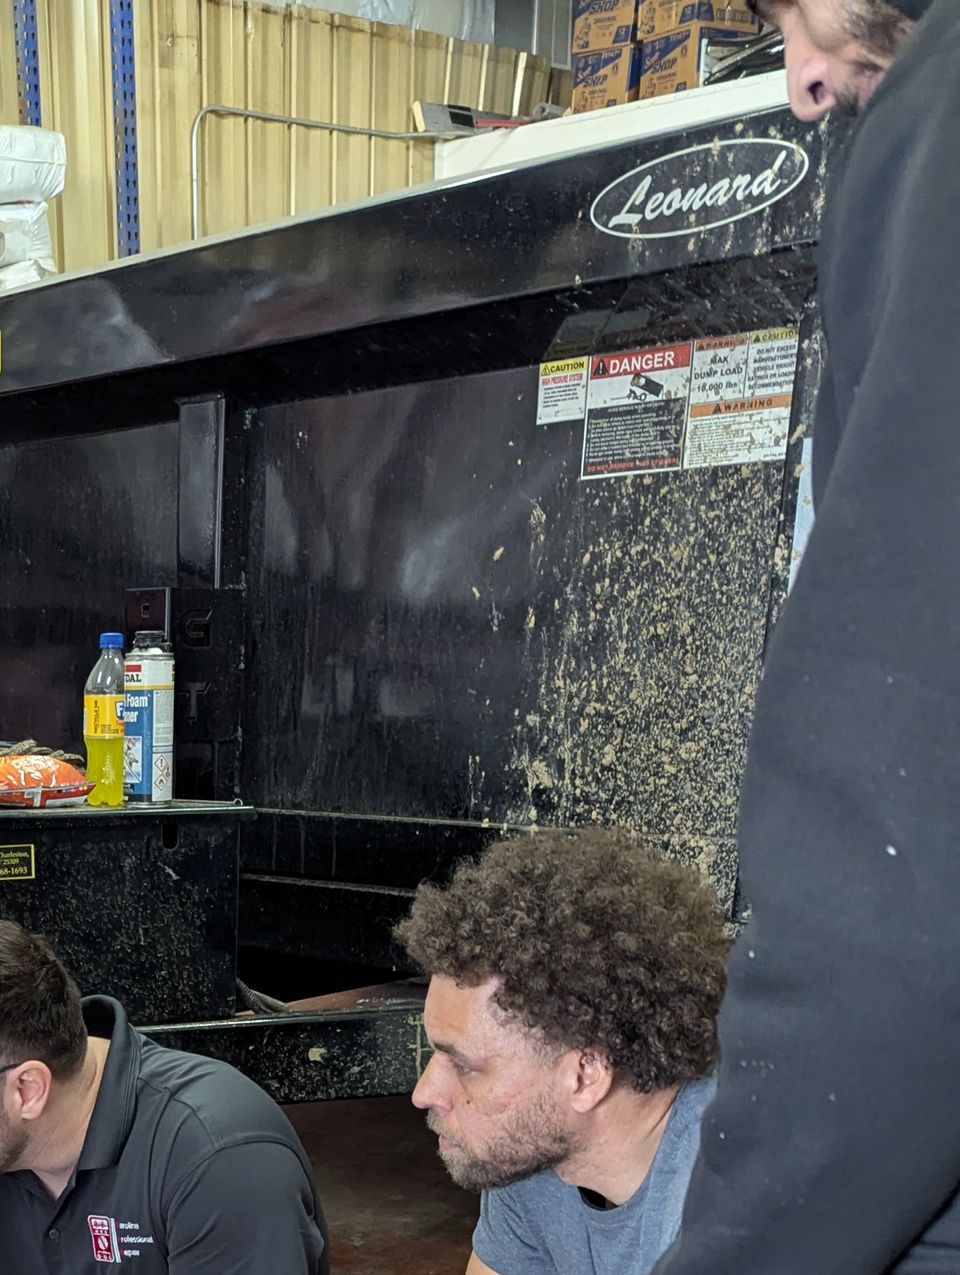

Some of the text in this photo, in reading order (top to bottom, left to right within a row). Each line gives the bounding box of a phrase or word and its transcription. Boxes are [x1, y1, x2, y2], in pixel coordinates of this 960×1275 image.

[608, 150, 787, 229] Leonard
[550, 361, 585, 373] CAUTION
[609, 351, 675, 374] DANGER
[694, 367, 743, 380] DUMP LOAD
[697, 381, 738, 393] 18,000 lbs
[724, 398, 773, 412] WARNING
[126, 693, 148, 708] Foam
